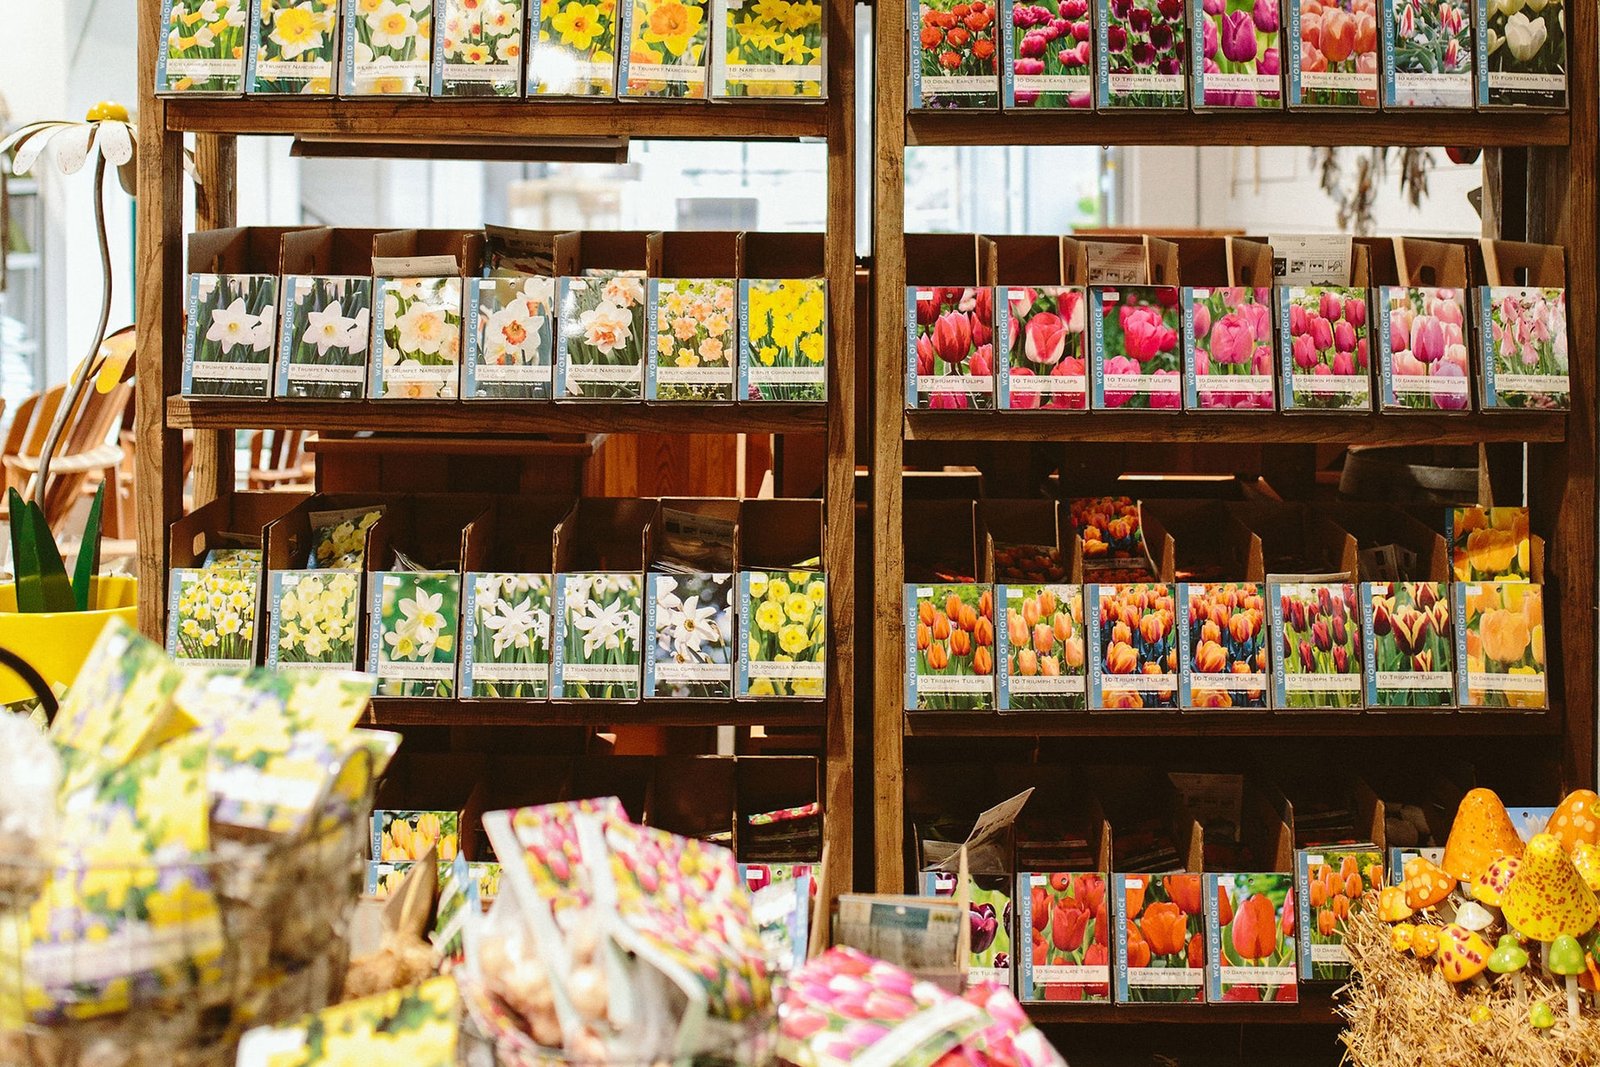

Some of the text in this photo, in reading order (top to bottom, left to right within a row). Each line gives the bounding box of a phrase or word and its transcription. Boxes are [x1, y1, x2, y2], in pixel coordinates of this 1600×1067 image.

[913, 45, 919, 56] OF
[1006, 44, 1012, 55] OF
[1100, 42, 1107, 53] OF
[1293, 40, 1299, 51] OF
[1387, 41, 1393, 52] OF
[1480, 41, 1486, 52] OF
[280, 296, 294, 374] WORLD OF CHOICE
[468, 298, 478, 376] WORLD OF CHOICE
[650, 335, 656, 346] OF
[741, 336, 748, 347] OF
[1096, 341, 1103, 353] OF
[1485, 341, 1492, 353] OF
[909, 343, 916, 355] OF
[1001, 343, 1008, 354] OF
[1283, 342, 1290, 354] OF
[1274, 606, 1282, 638] CHOICE
[1365, 603, 1373, 636] CHOICE
[466, 631, 472, 642] OF
[648, 630, 655, 642] OF
[741, 628, 748, 640] OF
[909, 642, 916, 654] OF
[1000, 643, 1007, 654] OF
[1092, 640, 1099, 653] OF
[1275, 640, 1283, 652] OF
[1367, 638, 1373, 650] OF
[1024, 932, 1031, 944] OF
[1212, 932, 1218, 944] OF
